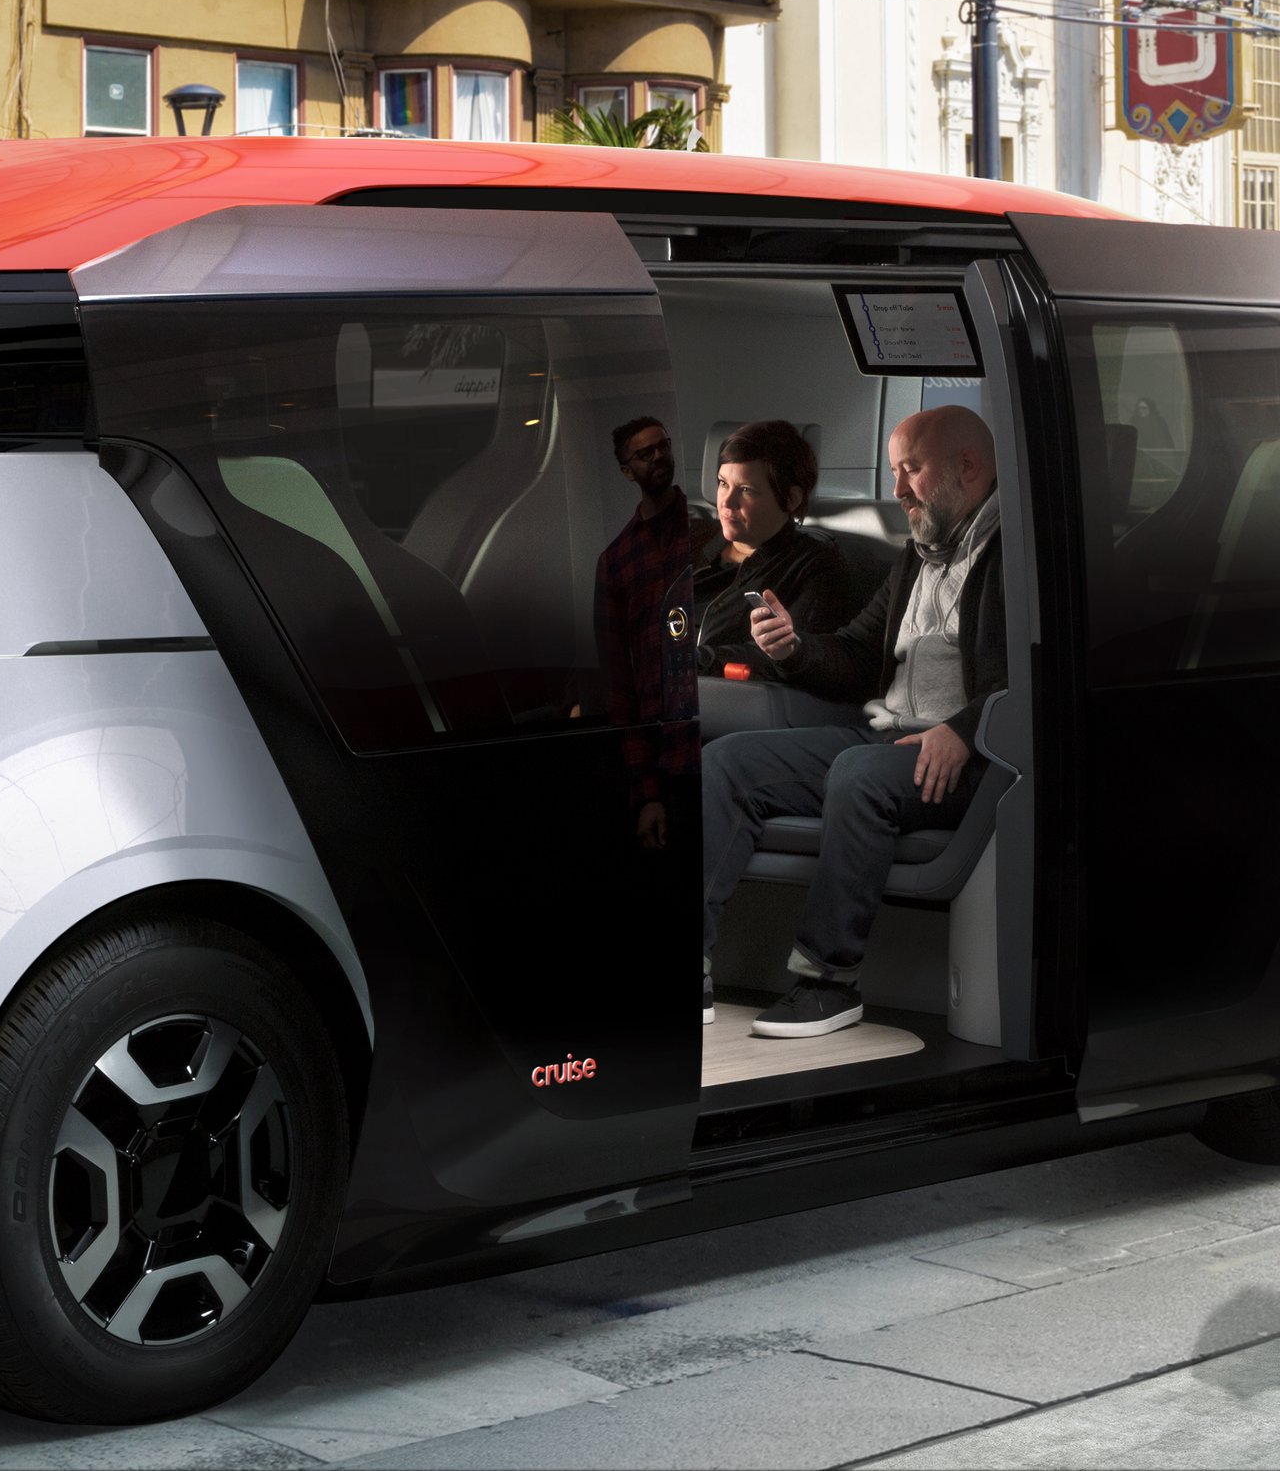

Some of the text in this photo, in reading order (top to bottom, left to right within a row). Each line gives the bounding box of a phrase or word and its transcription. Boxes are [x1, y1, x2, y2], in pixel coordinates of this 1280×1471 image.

[873, 304, 888, 313] Drop
[454, 374, 496, 398] dapper
[531, 1053, 597, 1088] cruise
[12, 973, 160, 1224] CONTINENTAL
